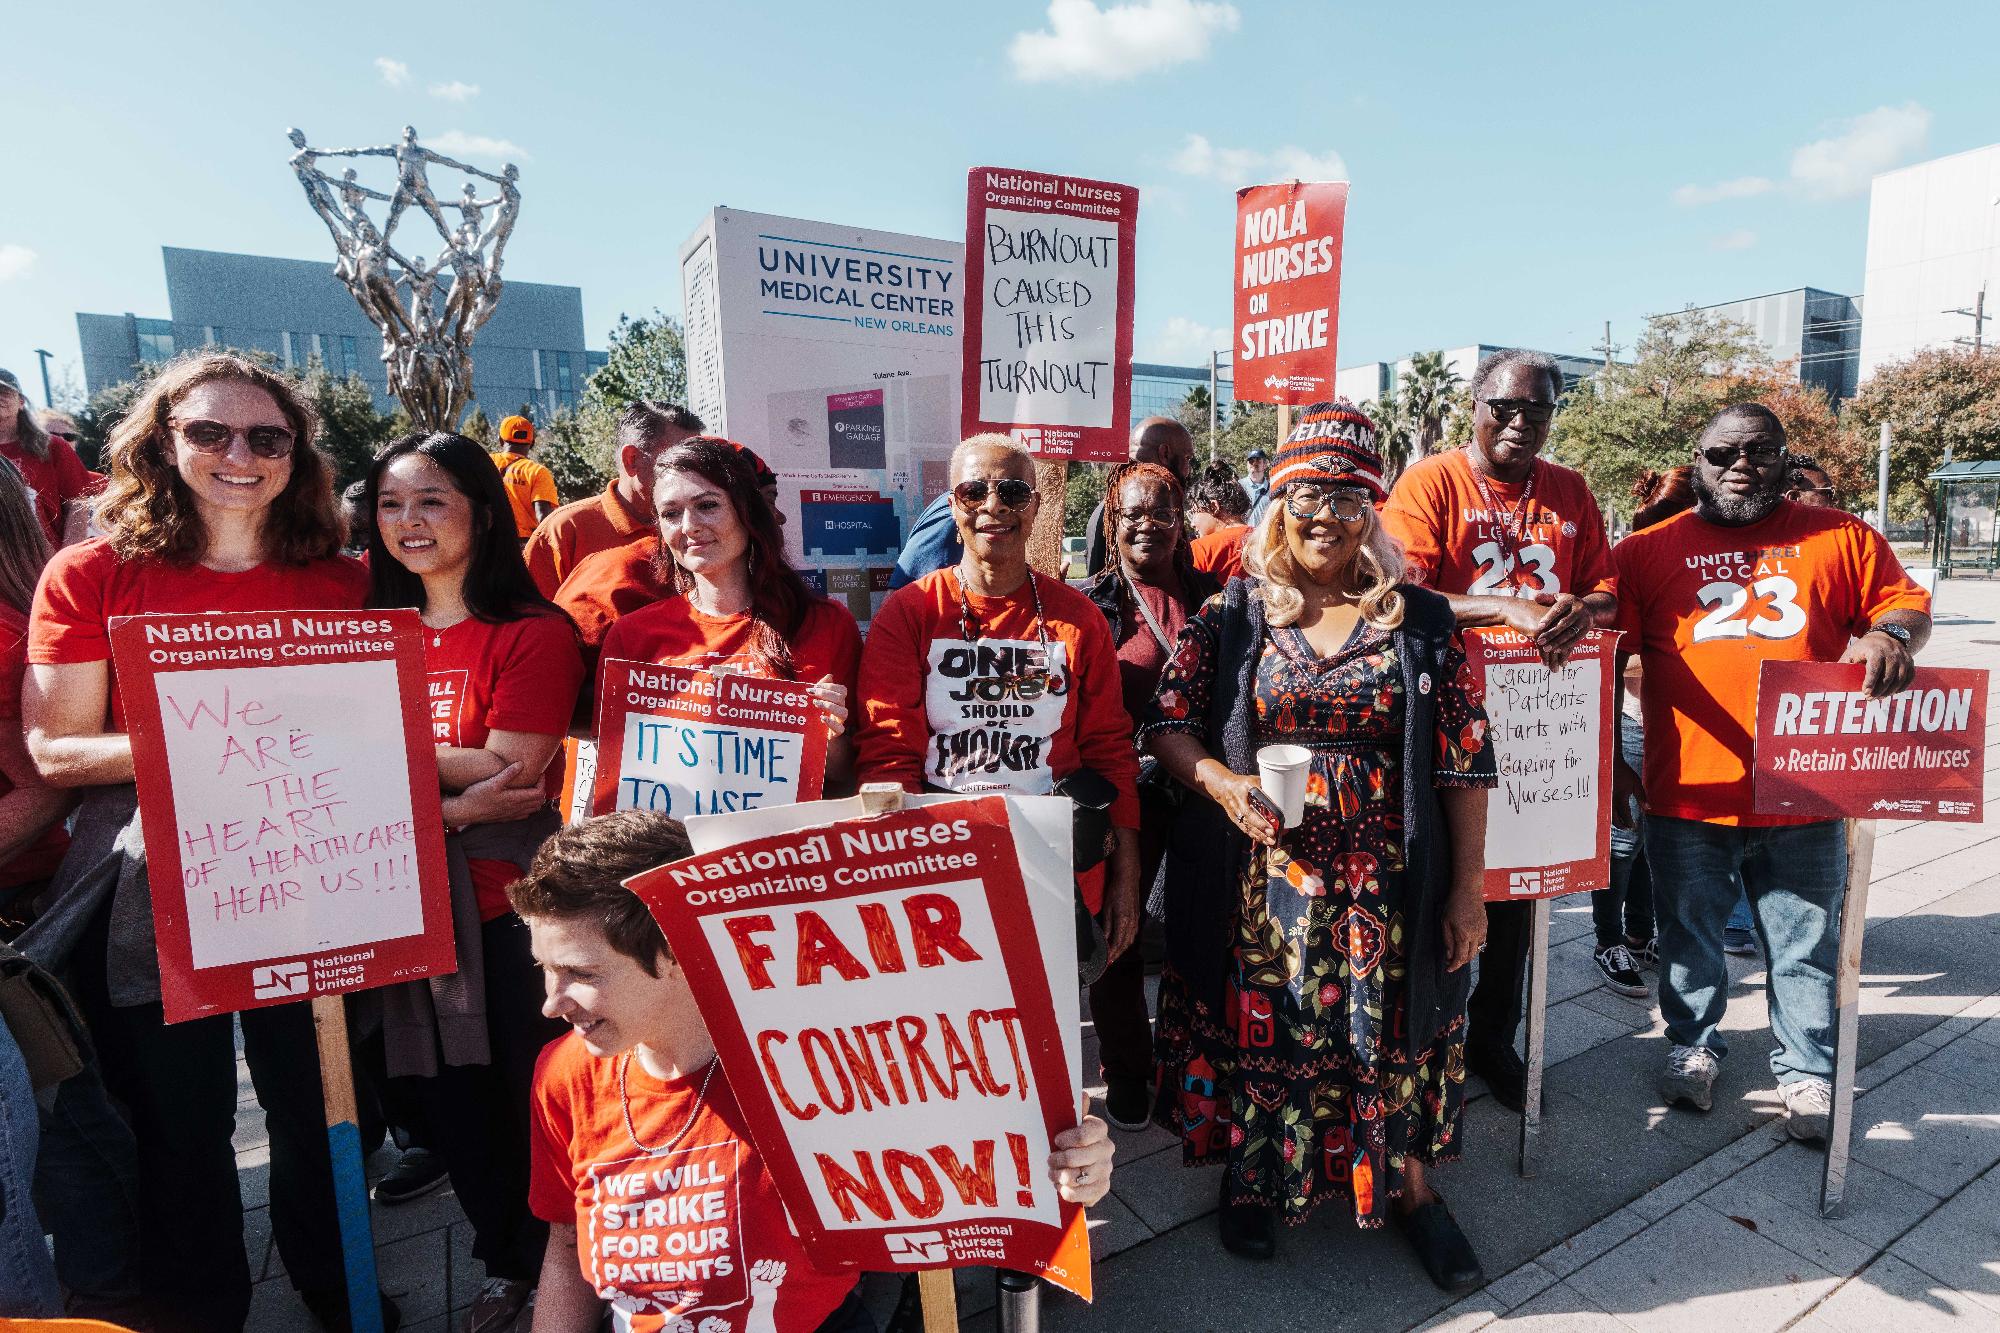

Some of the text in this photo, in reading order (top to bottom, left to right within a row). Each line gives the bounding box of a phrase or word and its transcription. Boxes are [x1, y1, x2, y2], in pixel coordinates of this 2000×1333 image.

[985, 191, 1121, 216] Organizing Committee
[986, 172, 1122, 203] National Nurses
[1243, 199, 1308, 249] NOLA
[988, 223, 1117, 268] BURNOUT
[758, 246, 953, 292] UNIVERSITY
[1242, 235, 1334, 289] NURSES
[760, 278, 954, 317] MEDICAL CENTER
[994, 277, 1092, 308] CAUSED
[1249, 292, 1268, 315] ON
[854, 316, 953, 337] NEW ORLEANS
[1006, 311, 1075, 348] THIS
[1241, 308, 1329, 361] STRIKE
[979, 358, 1108, 399] TURNOUT
[845, 423, 881, 433] PARKING
[846, 432, 881, 441] GARAGE
[1044, 429, 1080, 439] National
[1044, 446, 1073, 455] United
[823, 493, 873, 502] EMERGENCY
[834, 521, 873, 530] HOSPITAL
[1467, 541, 1561, 600] 23
[1702, 561, 1789, 580] LOCAL
[1693, 576, 1807, 644] 23
[145, 618, 393, 644] National Nurses
[149, 639, 395, 664] Organizing Committee
[938, 646, 1048, 678] ONE
[1483, 646, 1540, 660] Organizin
[428, 681, 456, 697] ILL
[627, 669, 809, 709] National Nurses
[167, 685, 283, 730] We
[626, 692, 807, 726] Organizing Committee
[960, 704, 1035, 719] SHOULD
[1773, 688, 1973, 736] RETENTION
[218, 733, 315, 775] ARE
[637, 721, 791, 784] IT'S TIME
[1787, 745, 1971, 772] Retain Skilled Nurses
[246, 768, 340, 809] THE
[185, 801, 348, 857] HEART
[184, 820, 415, 889] OF HEALTHCARE
[668, 818, 972, 888] National Nurses
[685, 852, 978, 907] Organizing Committee
[1543, 866, 1571, 877] National
[1543, 876, 1565, 886] Nurses
[212, 880, 305, 921] HEAR
[1543, 883, 1565, 893] United
[723, 892, 984, 990] FAIR
[313, 949, 374, 969] National
[314, 963, 364, 980] Nurses
[314, 974, 365, 992] United
[757, 1006, 1028, 1121] CONTRACT
[604, 1160, 726, 1198] WE WILL
[813, 1131, 1036, 1223] NOW!
[602, 1190, 727, 1230] STRIKE
[602, 1227, 730, 1259] FOR OUR
[946, 1224, 1013, 1239] National
[950, 1235, 1004, 1249] Nurses
[954, 1246, 1006, 1260] United
[603, 1255, 734, 1284] PATIENTS
